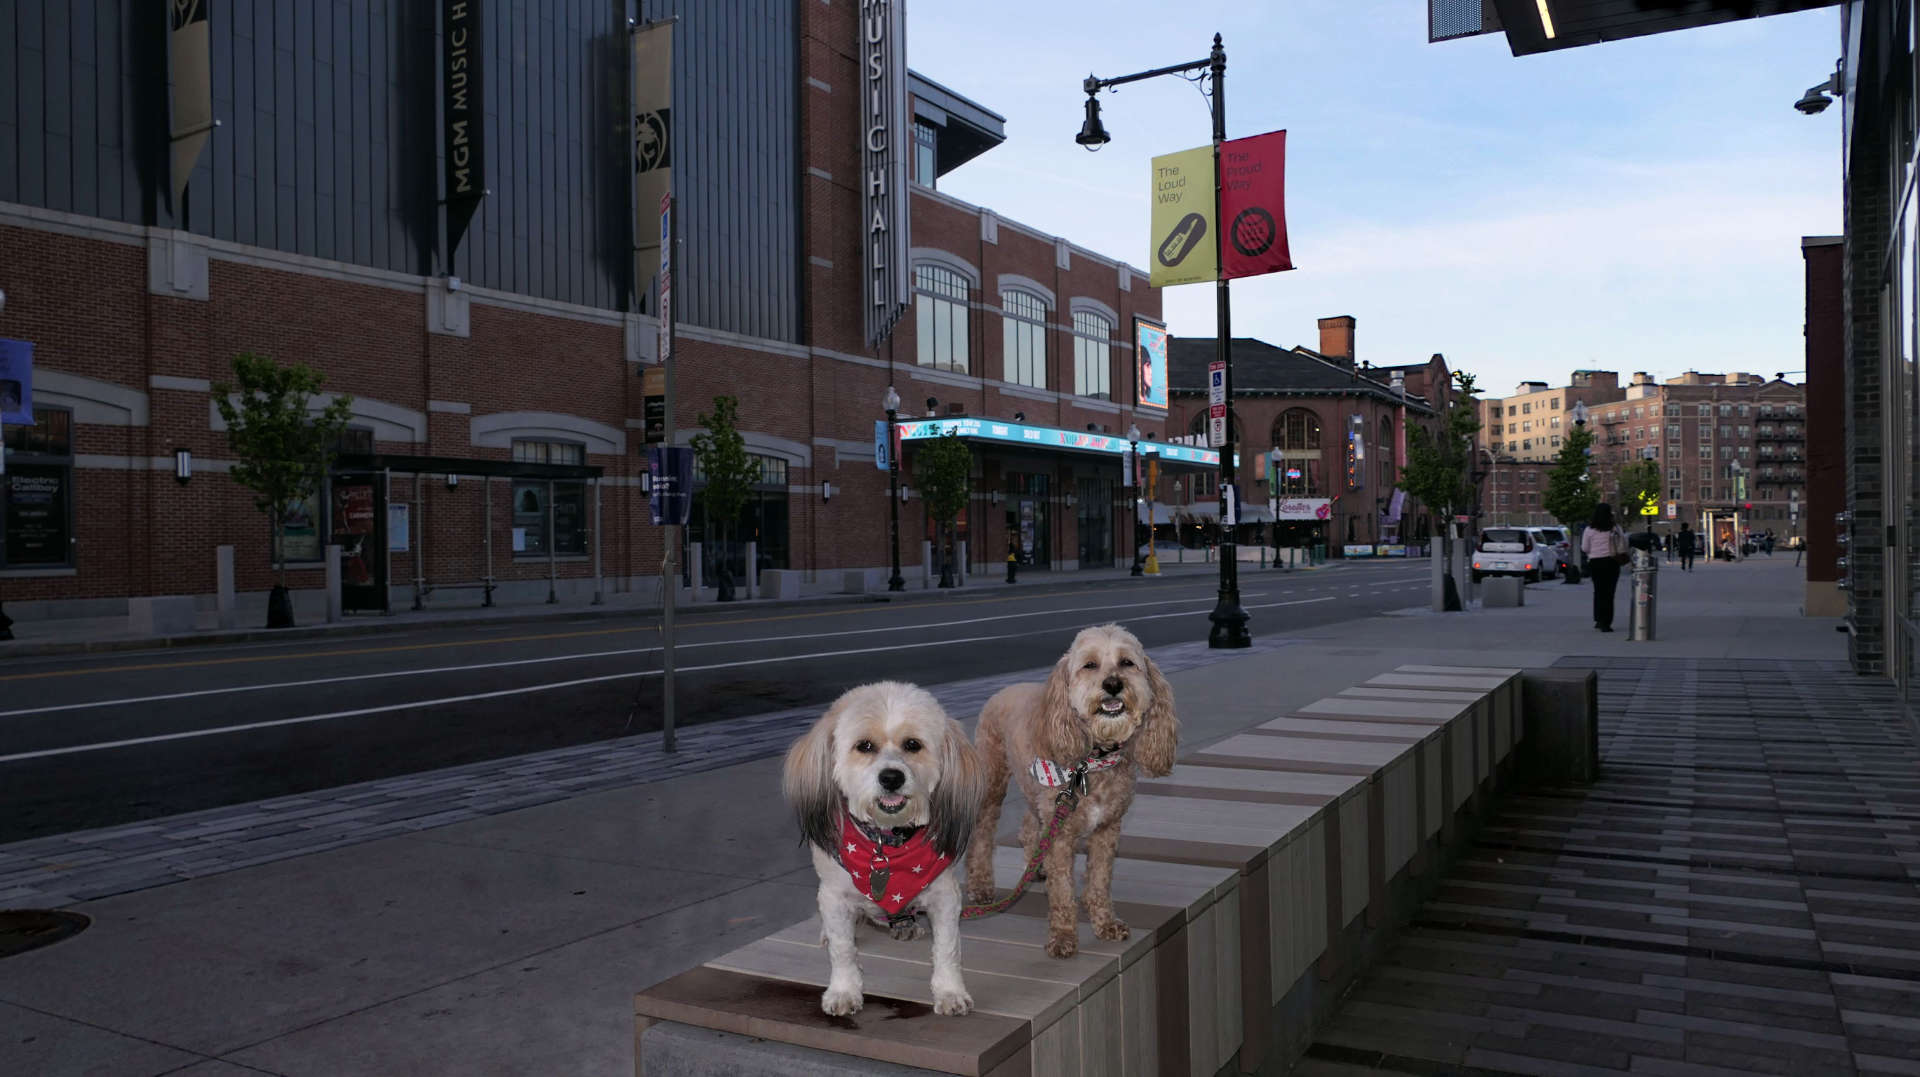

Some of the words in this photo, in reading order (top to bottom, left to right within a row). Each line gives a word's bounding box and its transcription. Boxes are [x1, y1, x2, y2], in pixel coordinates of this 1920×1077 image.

[452, 27, 468, 110] MUSIC
[453, 120, 471, 193] MGM
[1228, 152, 1249, 163] The
[1158, 167, 1179, 178] The
[1227, 160, 1262, 178] Proud
[1159, 176, 1186, 191] Loud
[1158, 192, 1183, 204] Way
[869, 169, 887, 306] HALL
